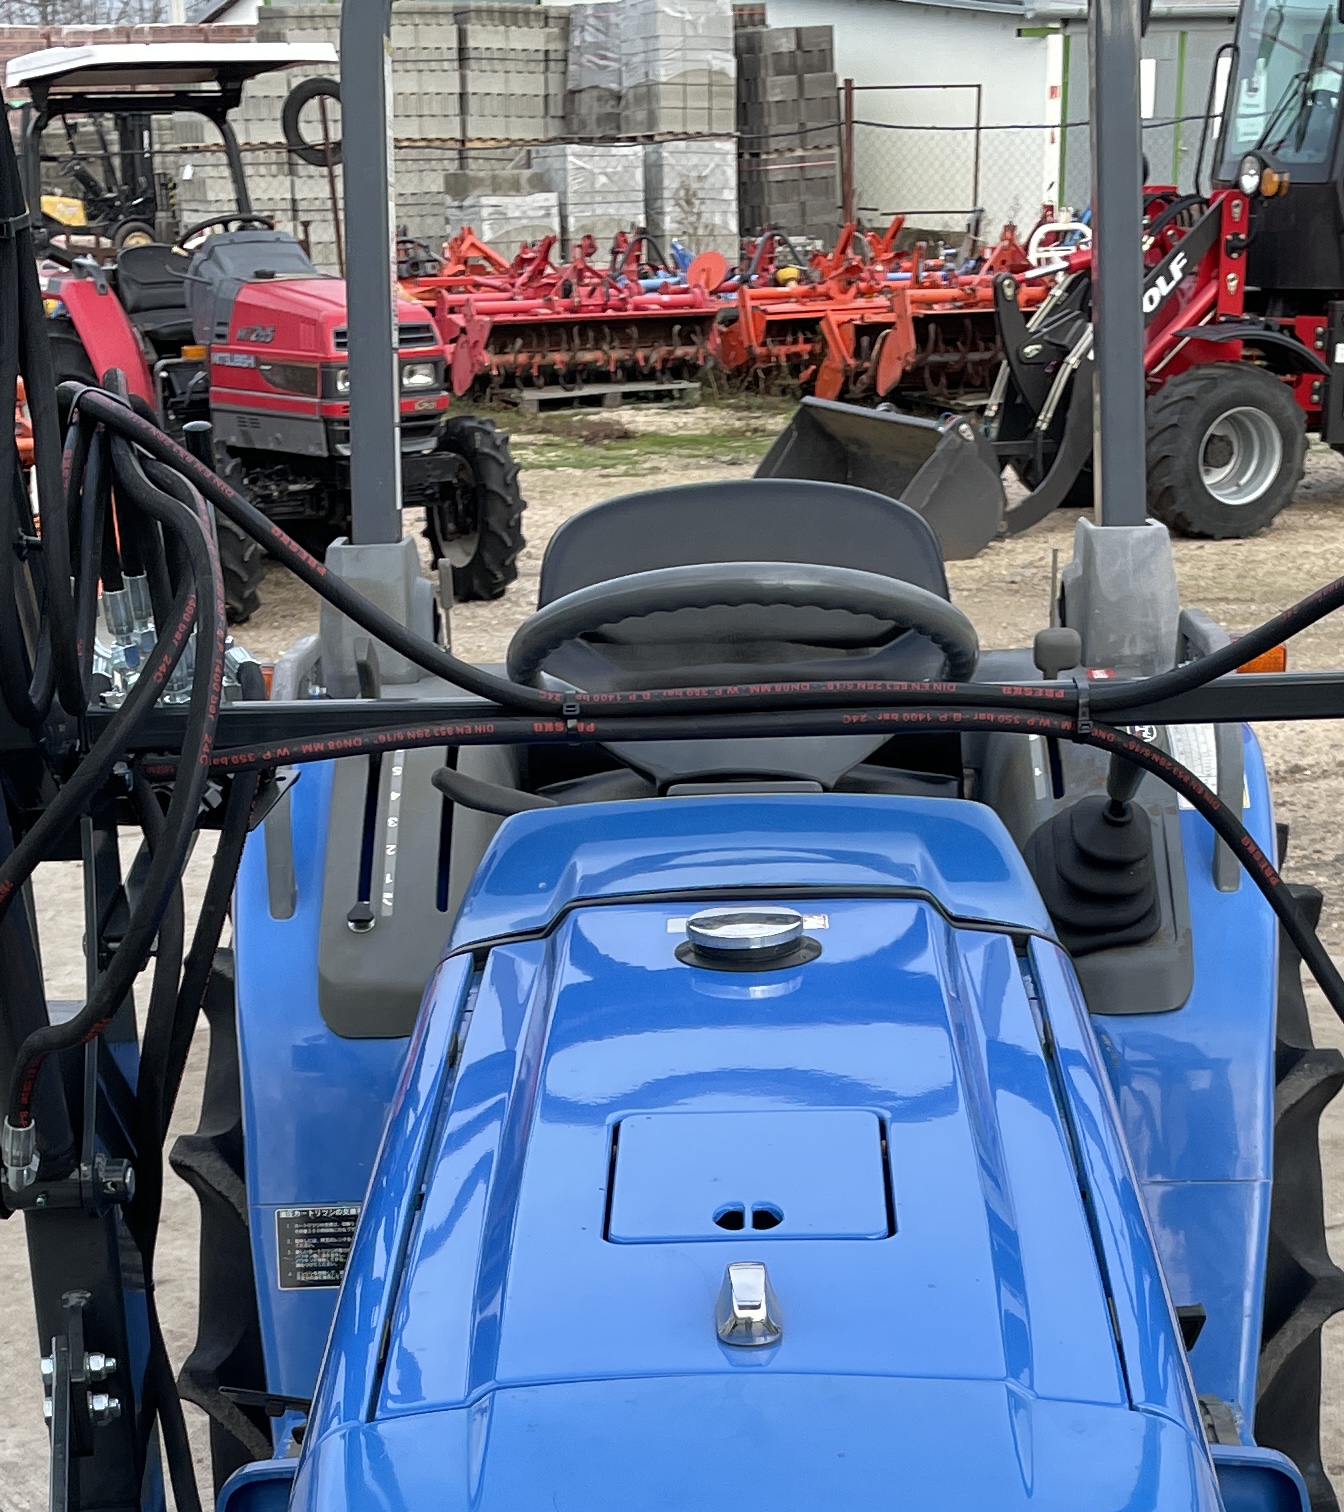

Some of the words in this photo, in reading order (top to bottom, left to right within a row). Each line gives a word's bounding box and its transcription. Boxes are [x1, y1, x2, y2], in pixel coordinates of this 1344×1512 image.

[1143, 250, 1187, 312] OLF
[153, 654, 172, 683] 24C
[933, 682, 956, 692] DIN
[575, 693, 591, 702] ba
[842, 714, 867, 724] 24C
[973, 712, 995, 723] bar
[434, 726, 454, 737] 853
[457, 725, 473, 736] EN
[475, 724, 495, 735] DIN
[533, 722, 596, 733] PRSKO
[302, 742, 324, 754] MM
[232, 752, 255, 764] 350
[392, 766, 402, 776] 5
[390, 791, 401, 801] 4
[387, 817, 399, 828] 3
[386, 845, 397, 855] 2
[385, 873, 393, 884] 1
